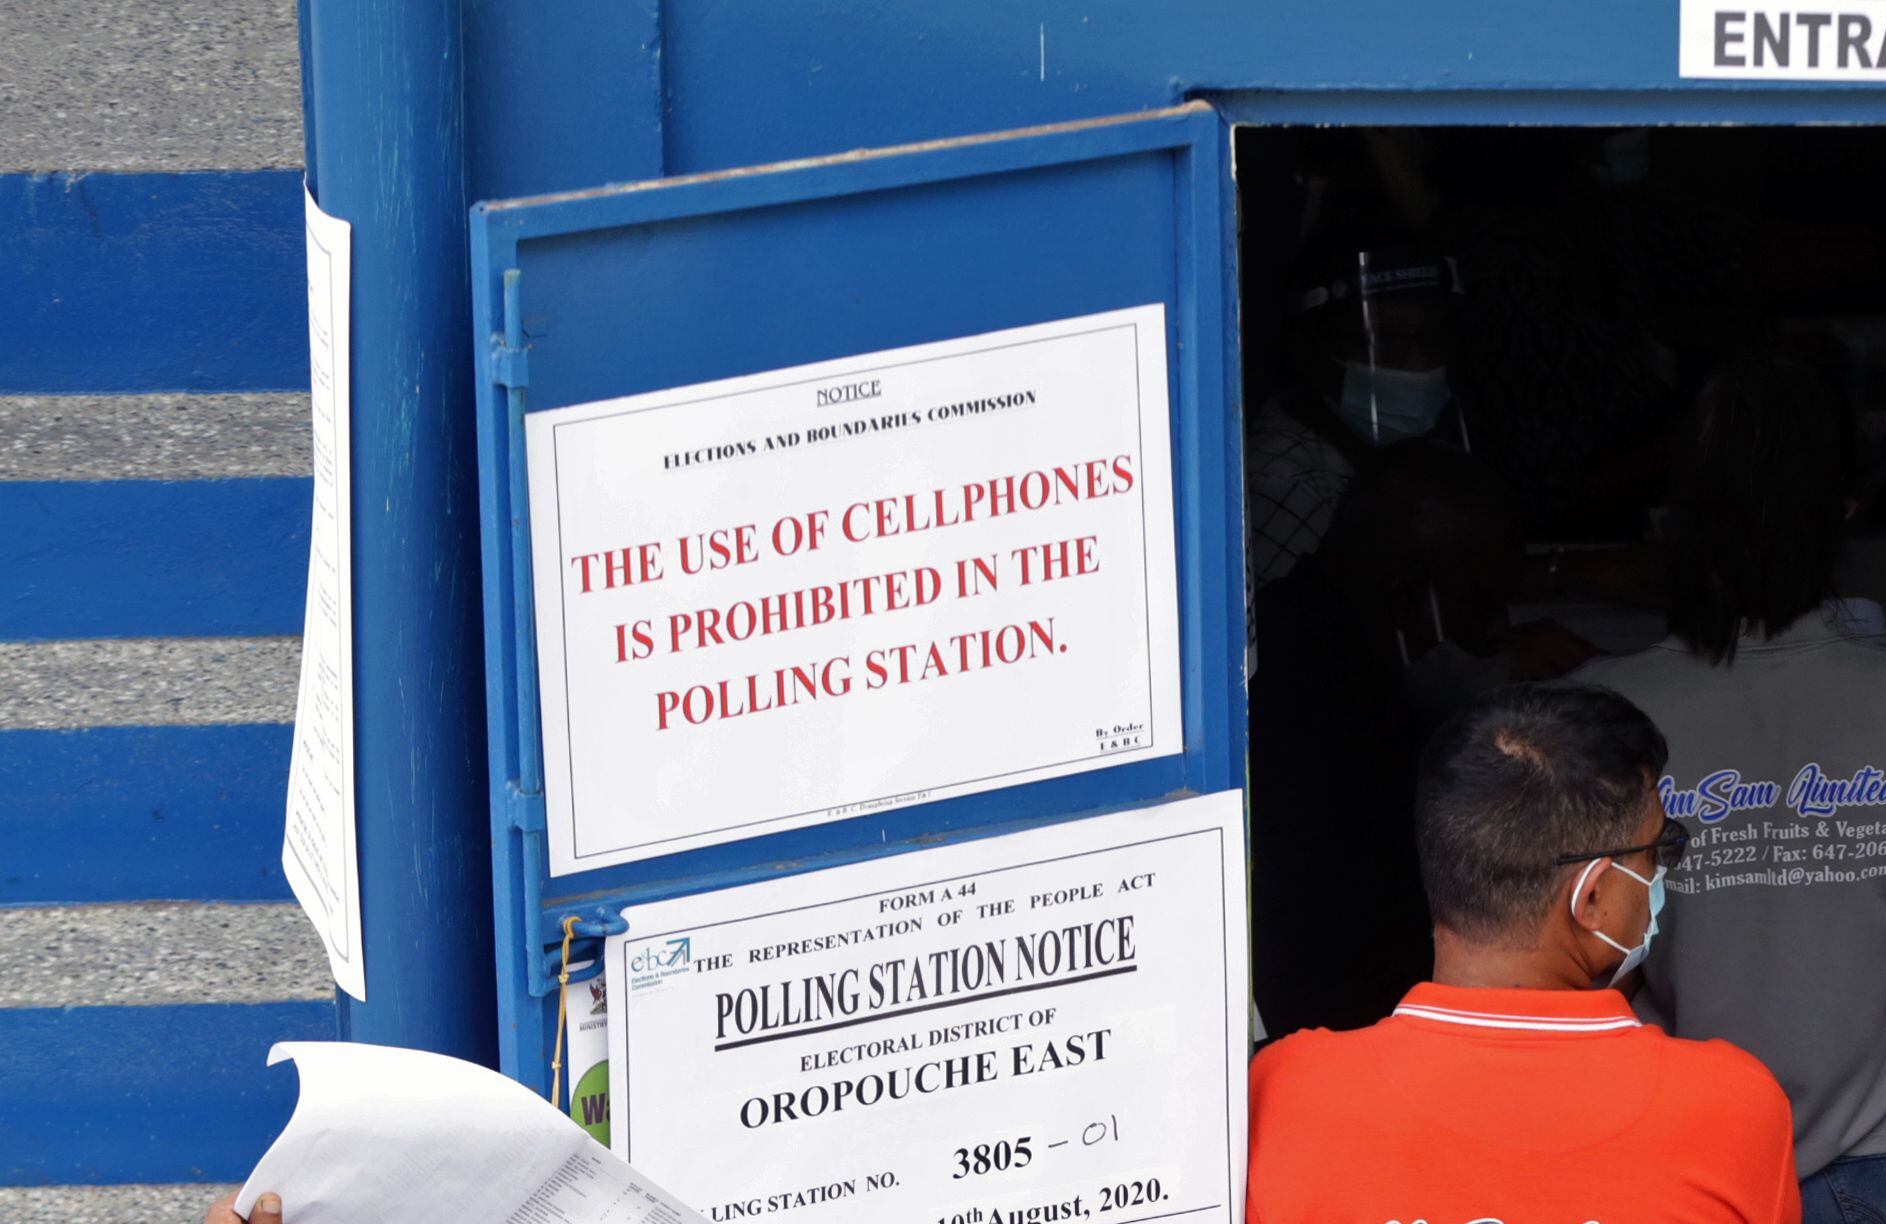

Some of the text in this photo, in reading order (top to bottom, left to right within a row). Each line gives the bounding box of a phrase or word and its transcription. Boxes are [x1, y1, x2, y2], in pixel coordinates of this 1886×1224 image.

[817, 380, 881, 406] NOTICE
[664, 390, 1037, 469] ELECTIONS AND BOUNDARIES COMMISSION
[572, 454, 1134, 594] THE USE OF CELLPHONES
[614, 535, 1100, 663] IS PROHIBITED IN THE
[655, 617, 1068, 731] POLLING STATION.
[1113, 723, 1144, 734] Order
[1674, 846, 1757, 873] 47-5222
[1773, 846, 1807, 864] Fax:
[1691, 829, 1708, 848] of
[1711, 824, 1758, 844] Fresh
[1763, 821, 1809, 840] Fruits
[1815, 820, 1829, 837] &
[879, 882, 976, 914] FORM A 44
[1664, 877, 1700, 894] mail:
[694, 873, 1156, 974] THE REPRESENTATION OF THE PEOPLE ACT
[716, 915, 1136, 1039] POLLING STATION NOTICE
[800, 1008, 1057, 1072] ELECTORAL DISTRICT OF
[740, 1029, 1112, 1128] OROPOUCHE EAST
[711, 1199, 762, 1222] LING
[768, 1179, 856, 1213] STATION
[866, 1171, 900, 1192] NO.
[953, 1136, 1033, 1179] 3805
[1082, 1114, 1119, 1146] 01
[1099, 1178, 1169, 1212] 2020.
